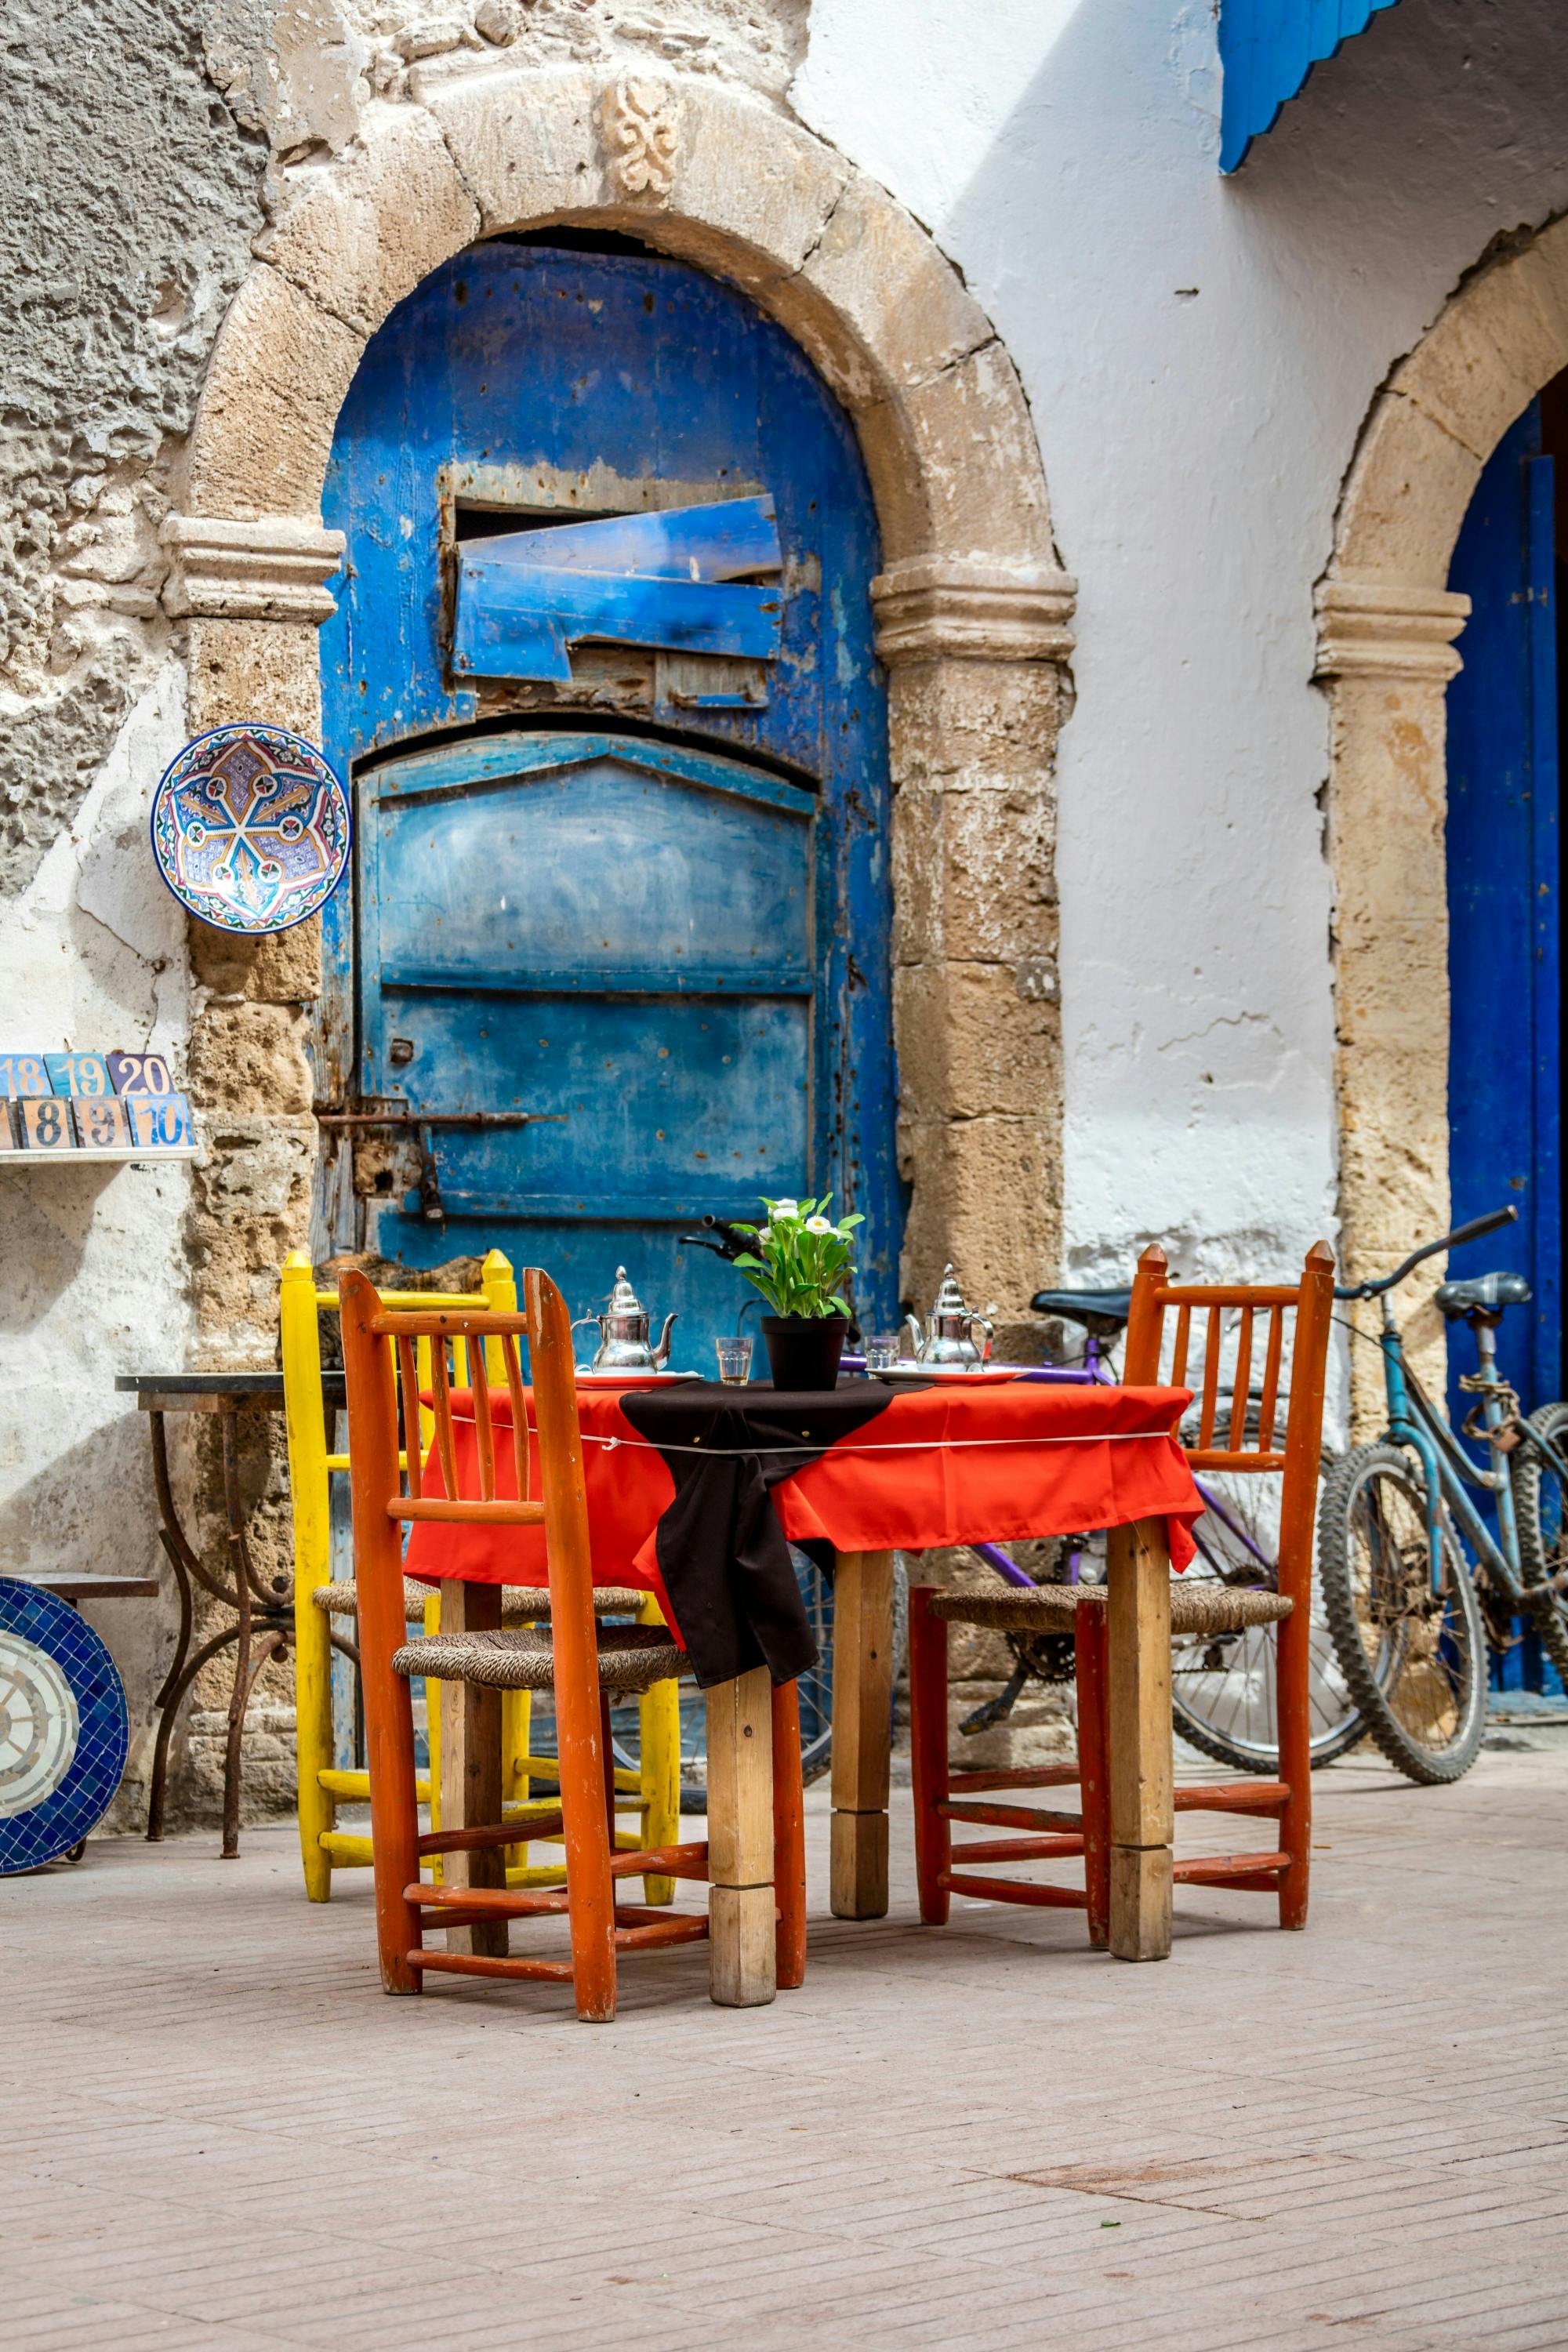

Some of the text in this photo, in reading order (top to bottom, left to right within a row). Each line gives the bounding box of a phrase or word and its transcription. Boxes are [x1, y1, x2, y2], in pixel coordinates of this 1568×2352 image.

[0, 1057, 169, 1097] 18 19 20
[36, 1100, 183, 1147] 8 9 10
